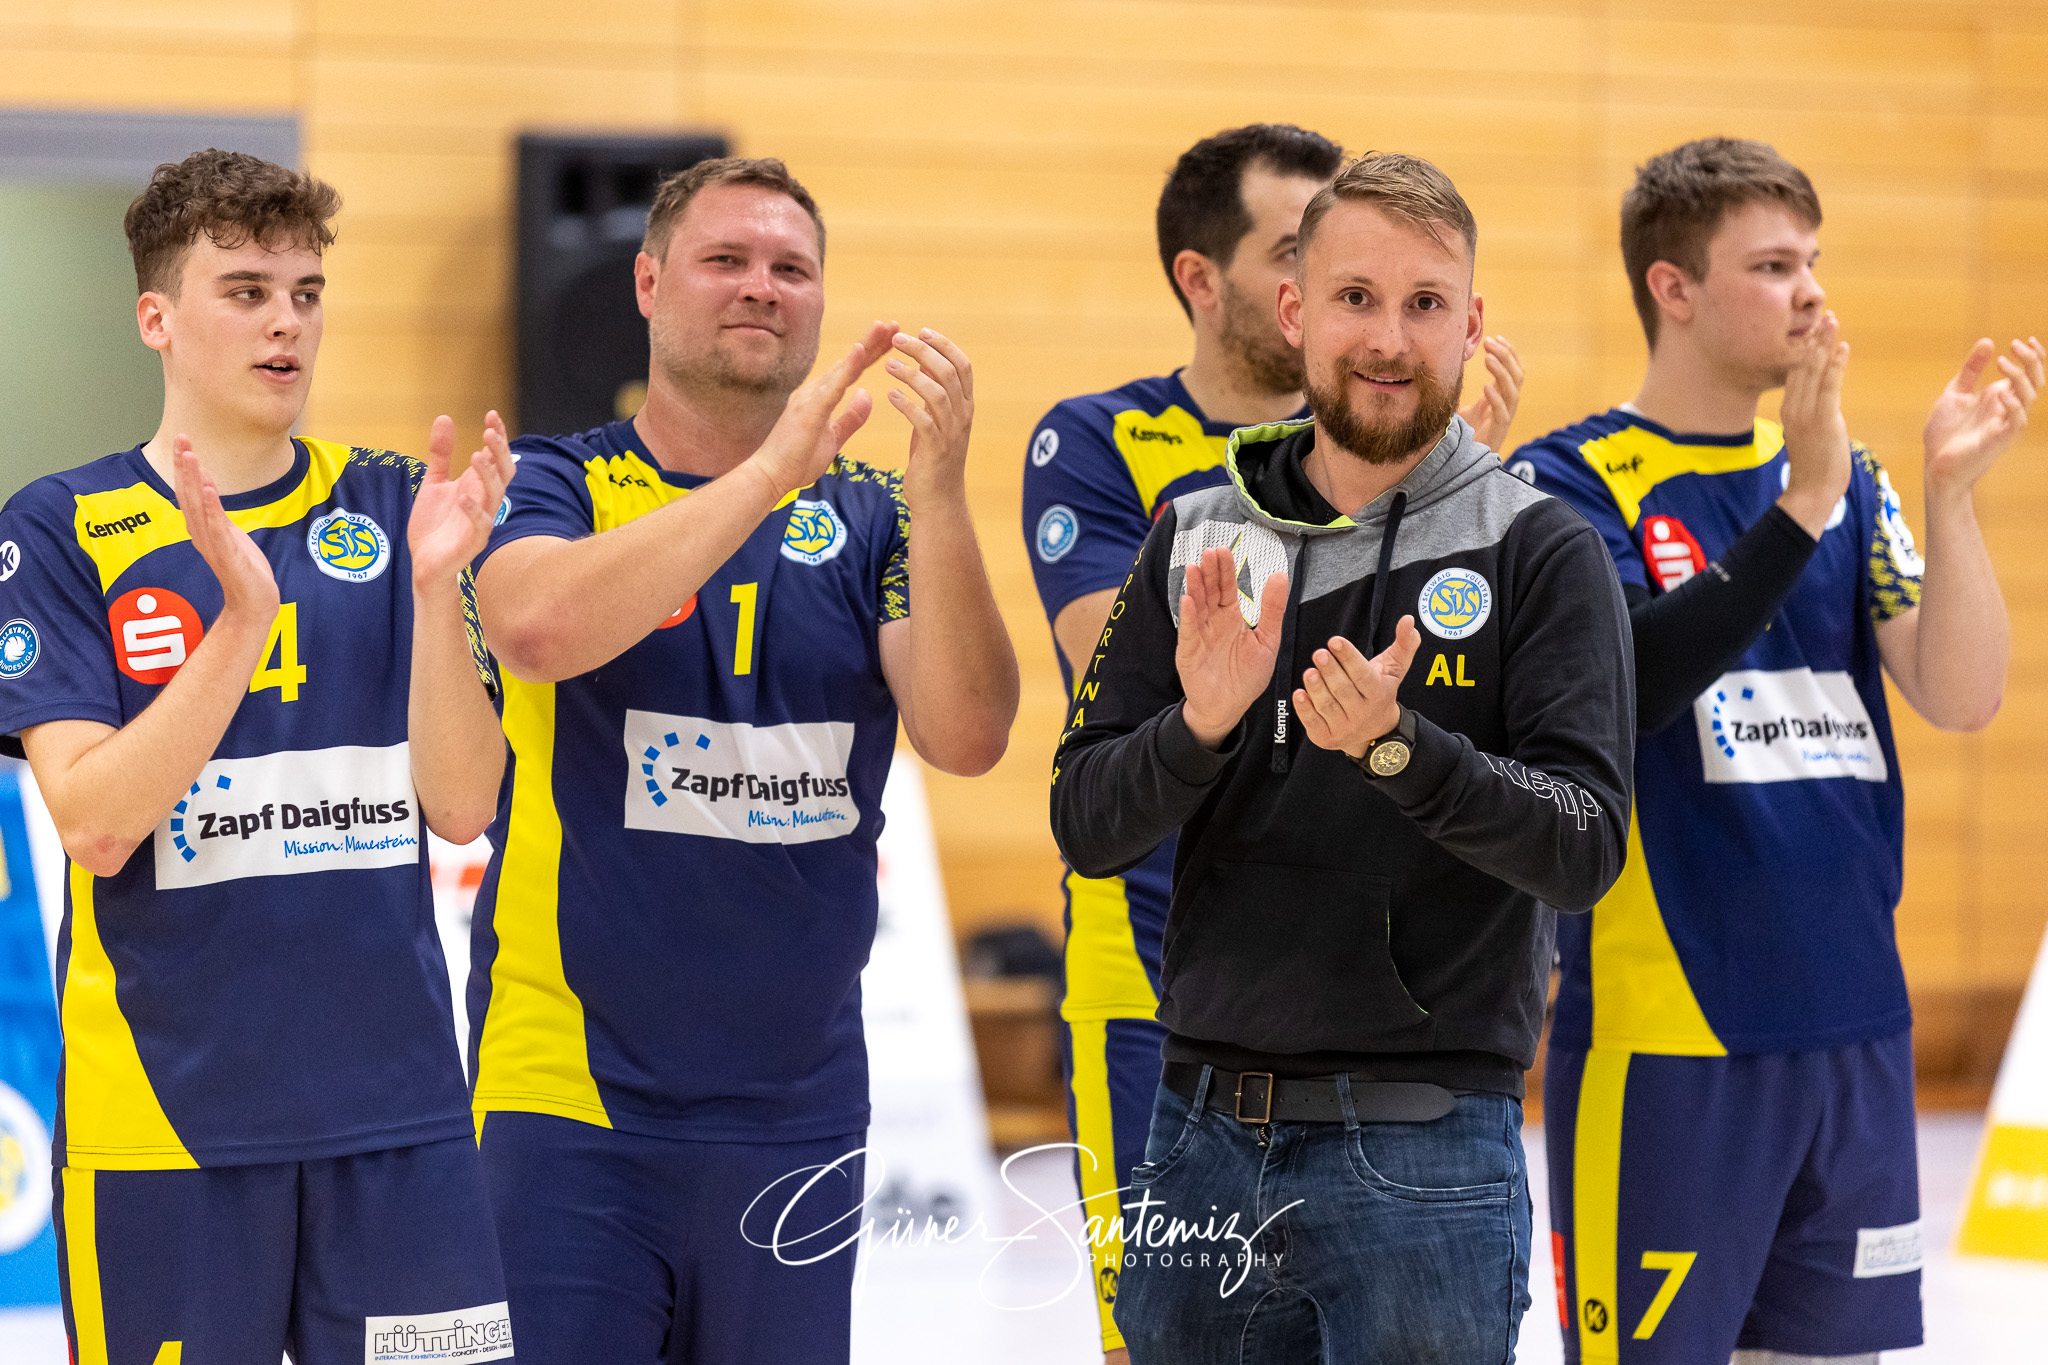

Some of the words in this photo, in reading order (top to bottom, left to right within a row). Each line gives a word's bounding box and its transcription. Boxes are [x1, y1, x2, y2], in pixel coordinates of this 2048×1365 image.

[347, 572, 368, 580] 1967
[1422, 572, 1451, 602] SCHWAIG
[1464, 572, 1489, 614] VOLLEYBALL
[730, 582, 758, 676] 1
[1444, 629, 1463, 637] 1967
[249, 602, 306, 703] 4
[1425, 653, 1476, 687] AL
[1274, 699, 1289, 744] Kempa
[1731, 715, 1789, 746] Zapf
[671, 766, 744, 802] Zapf
[198, 804, 275, 840] Zapf
[281, 797, 410, 831] Daigfuss
[1632, 1250, 1698, 1340] 7
[451, 1348, 479, 1358] CONCEPT
